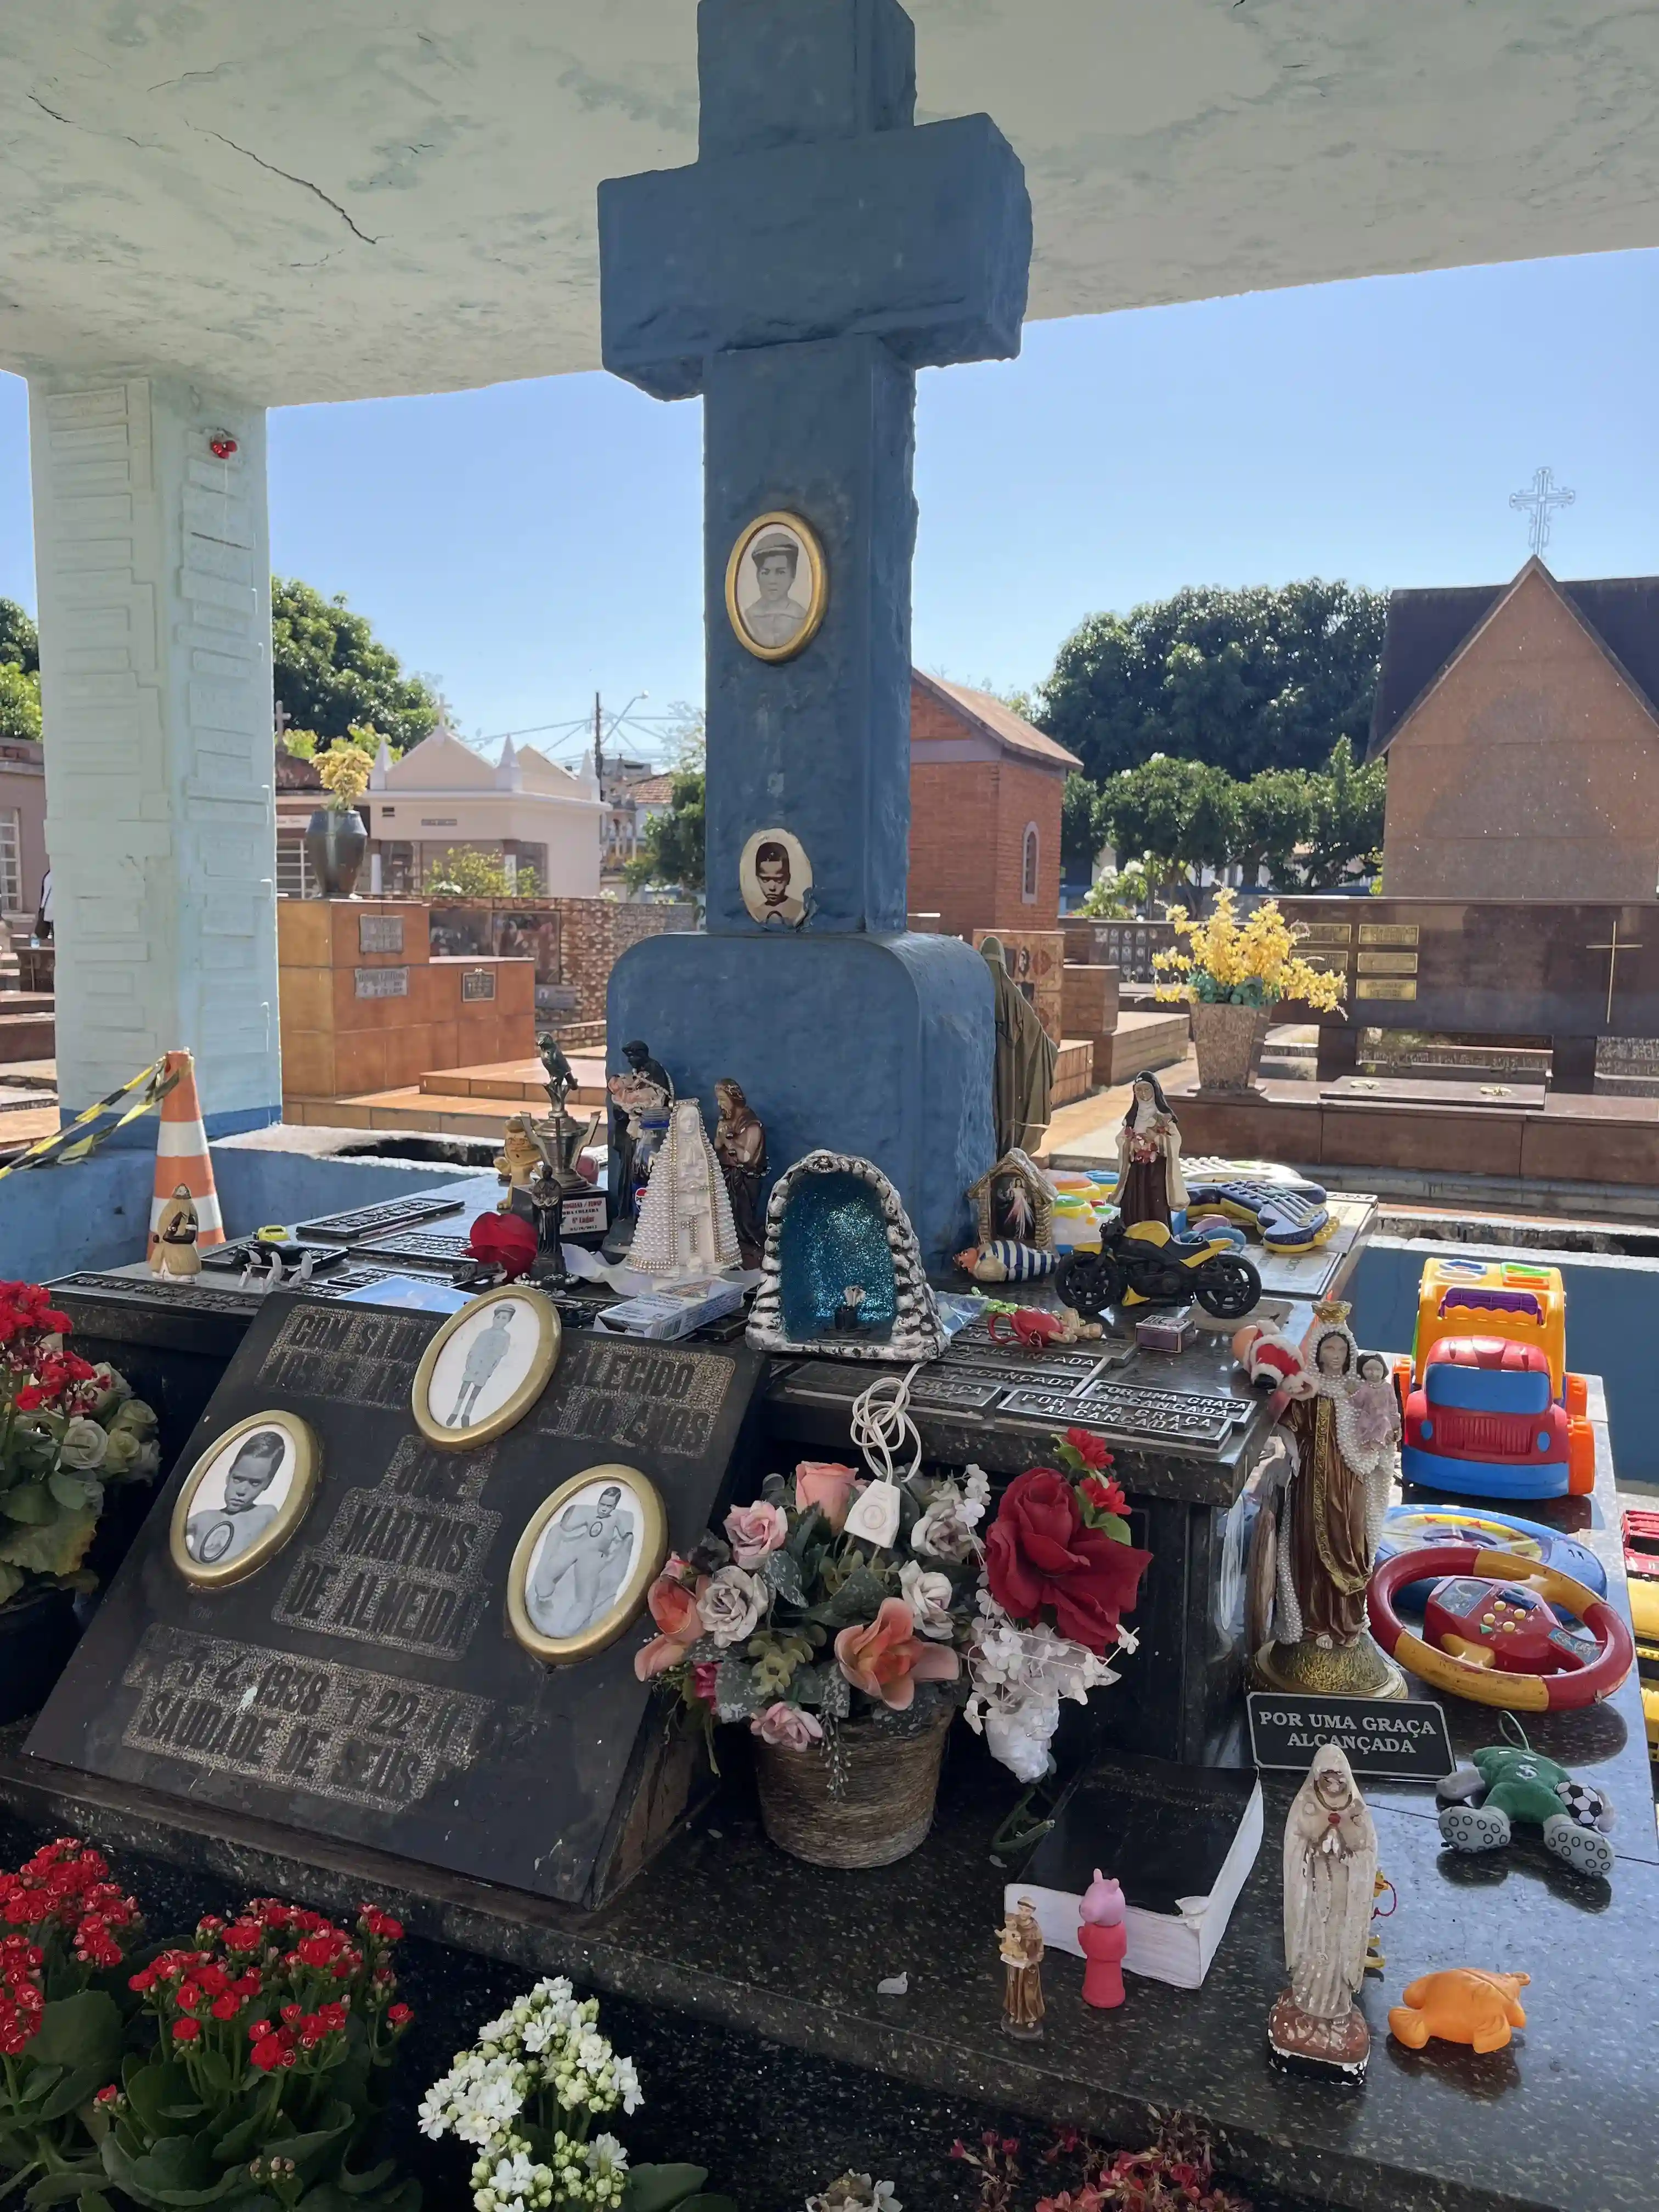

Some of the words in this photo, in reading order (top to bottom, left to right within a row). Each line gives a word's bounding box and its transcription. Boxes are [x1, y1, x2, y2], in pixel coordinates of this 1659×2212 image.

[1021, 1393, 1066, 1407] POR
[1079, 1400, 1123, 1415] UMA
[1135, 1408, 1211, 1427] GRAÇA
[1096, 1384, 1133, 1396] POR
[1139, 1390, 1178, 1402] UMA
[1187, 1396, 1246, 1410] GRAÇA
[340, 1504, 479, 1574] MARTINS
[283, 1562, 341, 1619] DE
[335, 1573, 478, 1652] ALMEIDA
[1259, 1711, 1304, 1728] POR
[1308, 1713, 1357, 1730] UMA
[1362, 1717, 1437, 1739] GRAÇA
[137, 1692, 278, 1763] SAUDADE
[279, 1726, 329, 1779] DE
[331, 1736, 422, 1799] SEUS
[1287, 1733, 1417, 1755] ALCANÇADA
